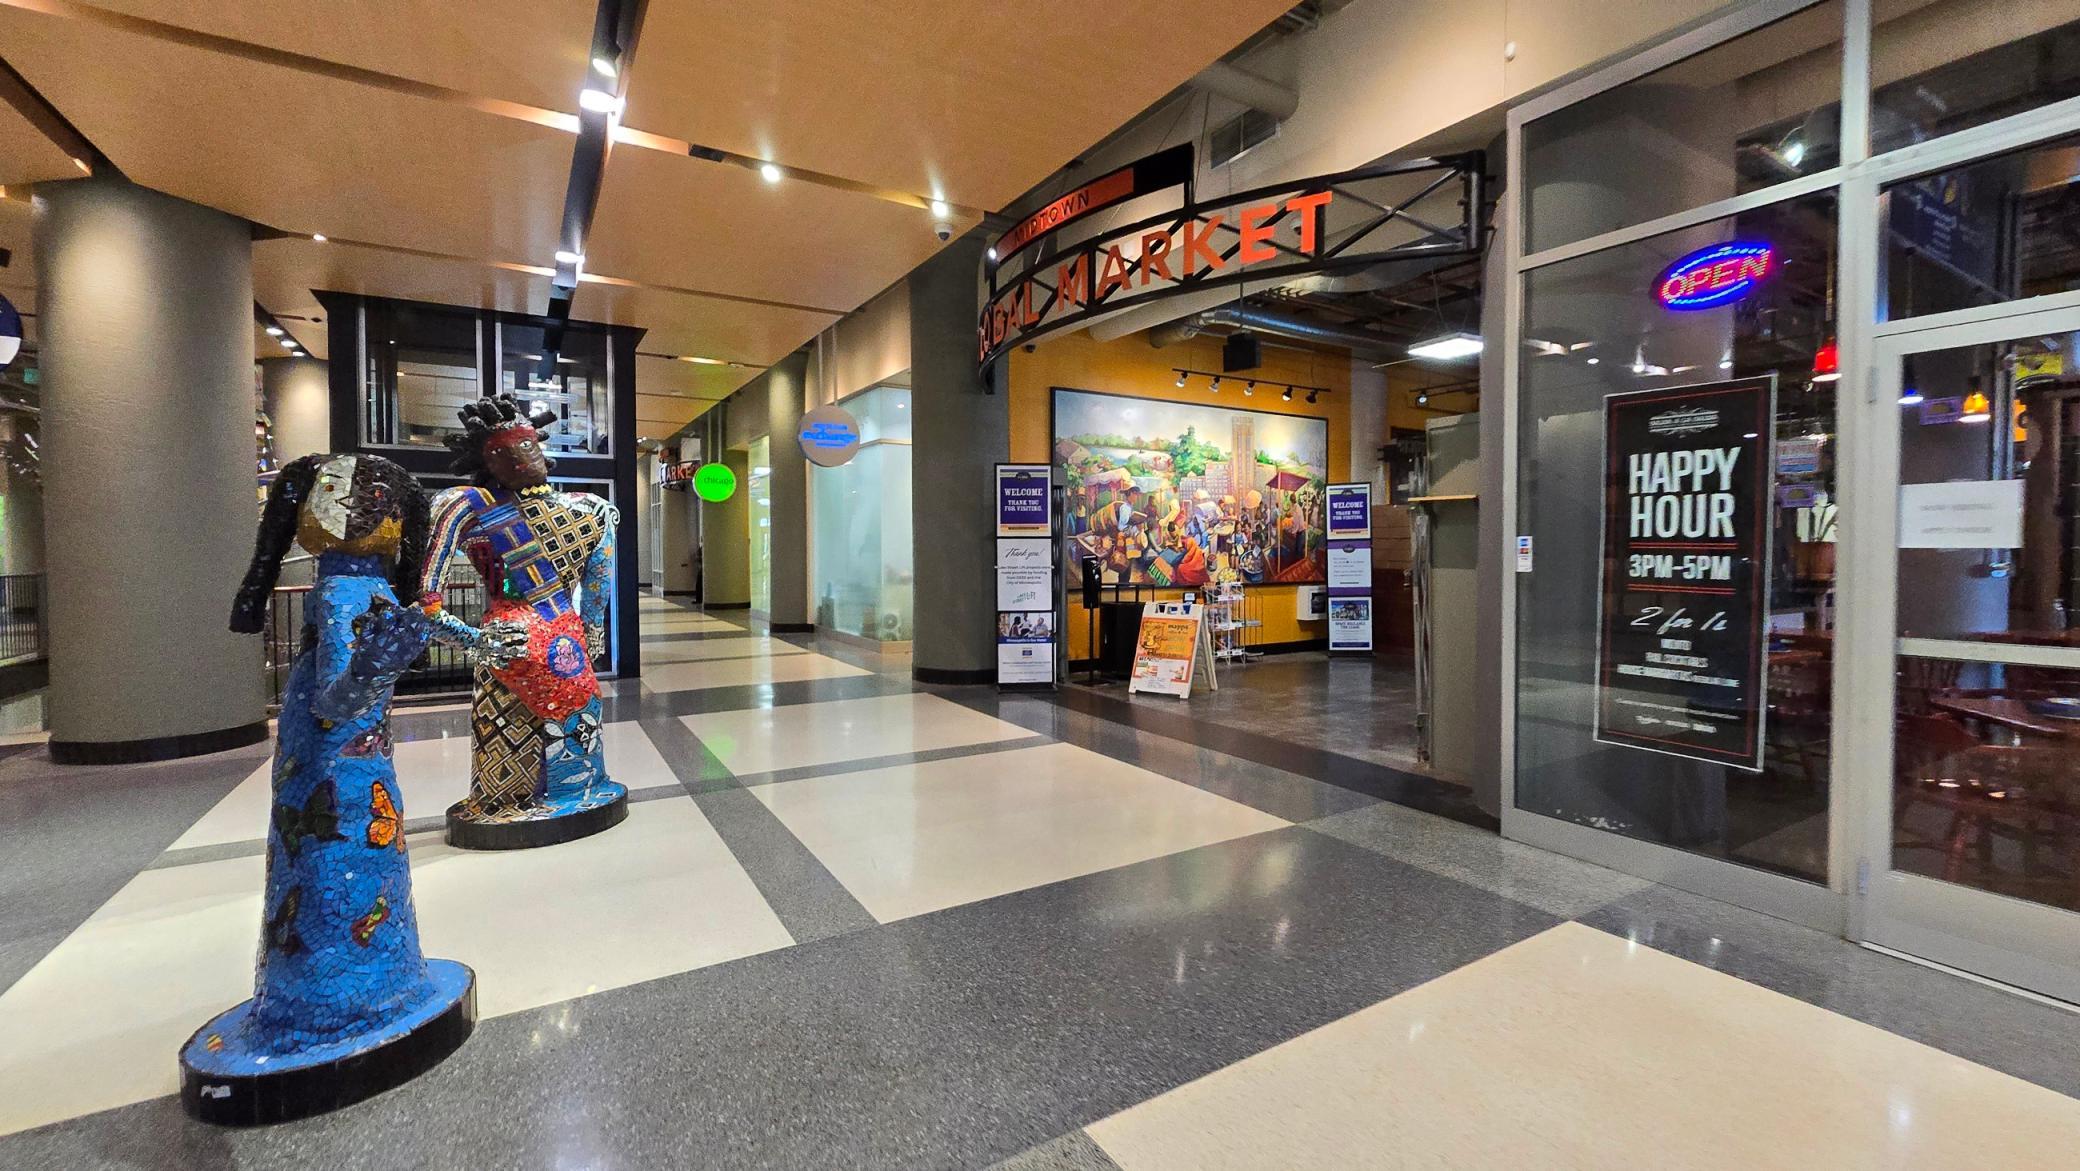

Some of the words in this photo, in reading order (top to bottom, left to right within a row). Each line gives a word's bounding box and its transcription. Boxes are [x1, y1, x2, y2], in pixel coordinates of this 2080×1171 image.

[1056, 190, 1333, 314] MARKET
[1661, 249, 1771, 300] OPEN
[1628, 446, 1742, 495] HAPPY
[1004, 488, 1043, 496] WELCOME
[1629, 492, 1736, 538] HOUR
[1004, 547, 1028, 559] Thank
[1628, 554, 1731, 580] 3PM-5PM
[1630, 606, 1664, 626] 2
